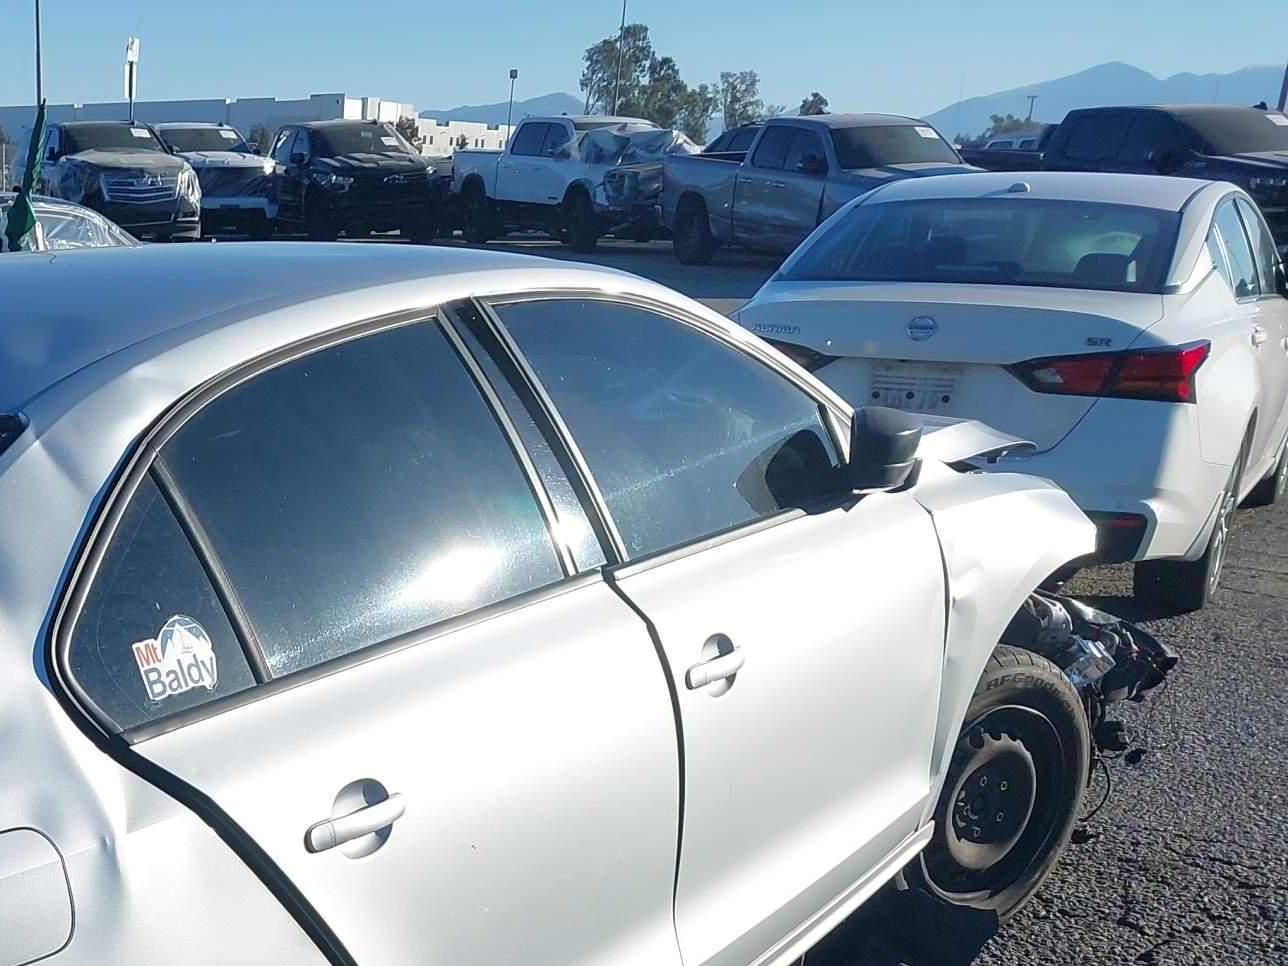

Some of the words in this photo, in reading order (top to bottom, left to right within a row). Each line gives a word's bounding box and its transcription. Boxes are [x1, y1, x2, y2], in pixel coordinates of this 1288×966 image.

[1085, 336, 1112, 347] SR
[135, 643, 162, 668] Mt
[143, 653, 216, 698] Baldy
